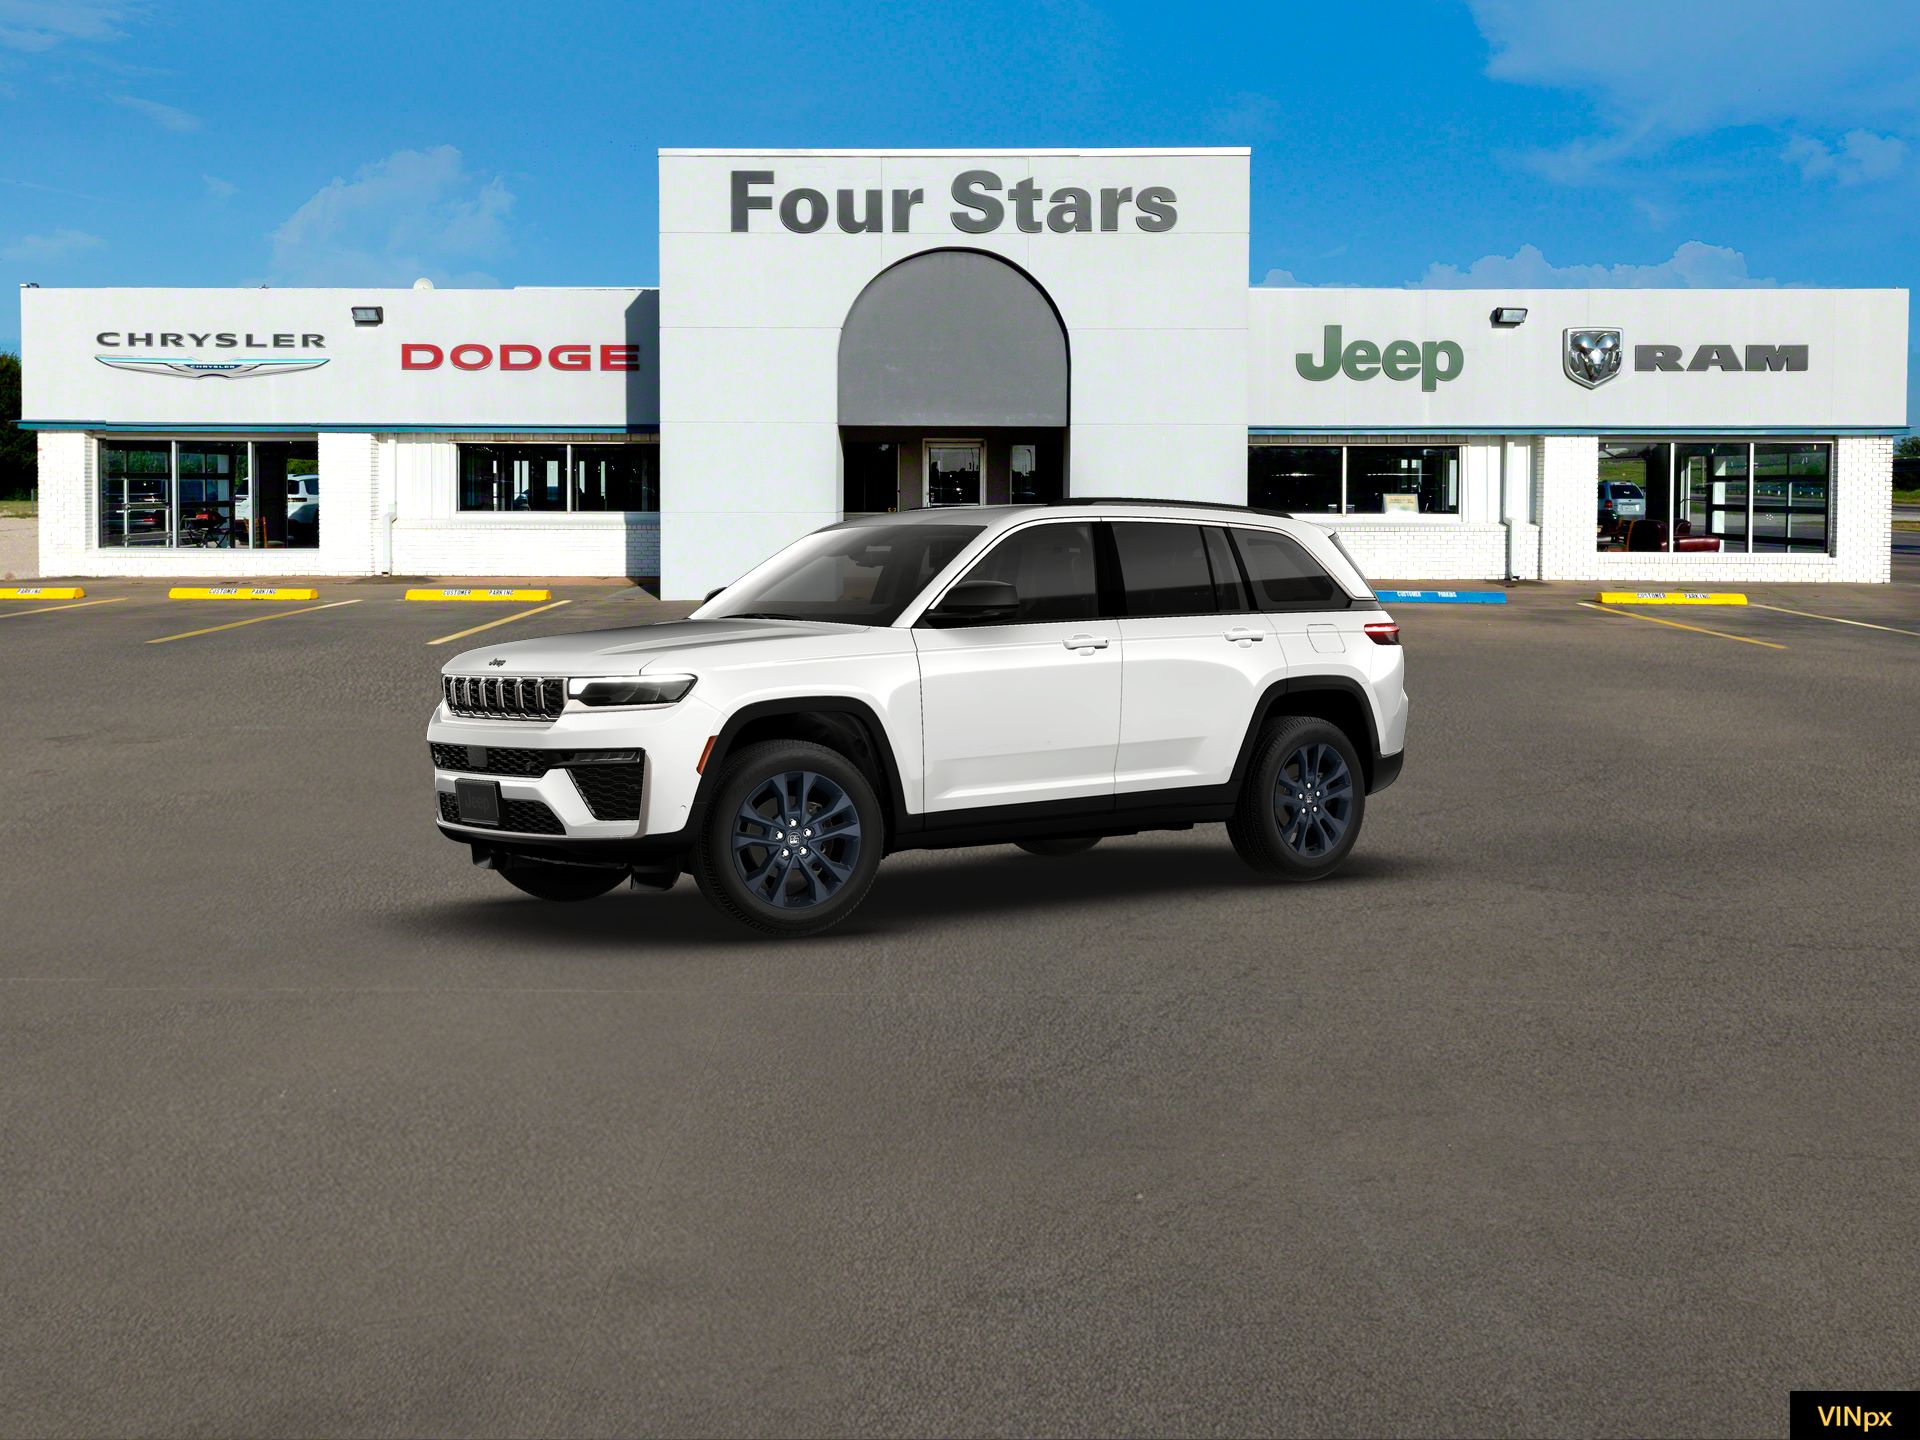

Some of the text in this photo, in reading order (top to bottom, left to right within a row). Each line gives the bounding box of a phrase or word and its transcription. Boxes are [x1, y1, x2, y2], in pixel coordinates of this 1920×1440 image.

[730, 170, 1178, 234] Four Stars
[96, 331, 327, 349] CHRYSLER
[401, 343, 640, 371] DODGE
[1295, 324, 1464, 392] Jeep
[1634, 344, 1809, 372] RAM
[1396, 590, 1422, 598] CUSTOMER
[488, 657, 507, 668] Jeep
[464, 790, 490, 814] Jeep
